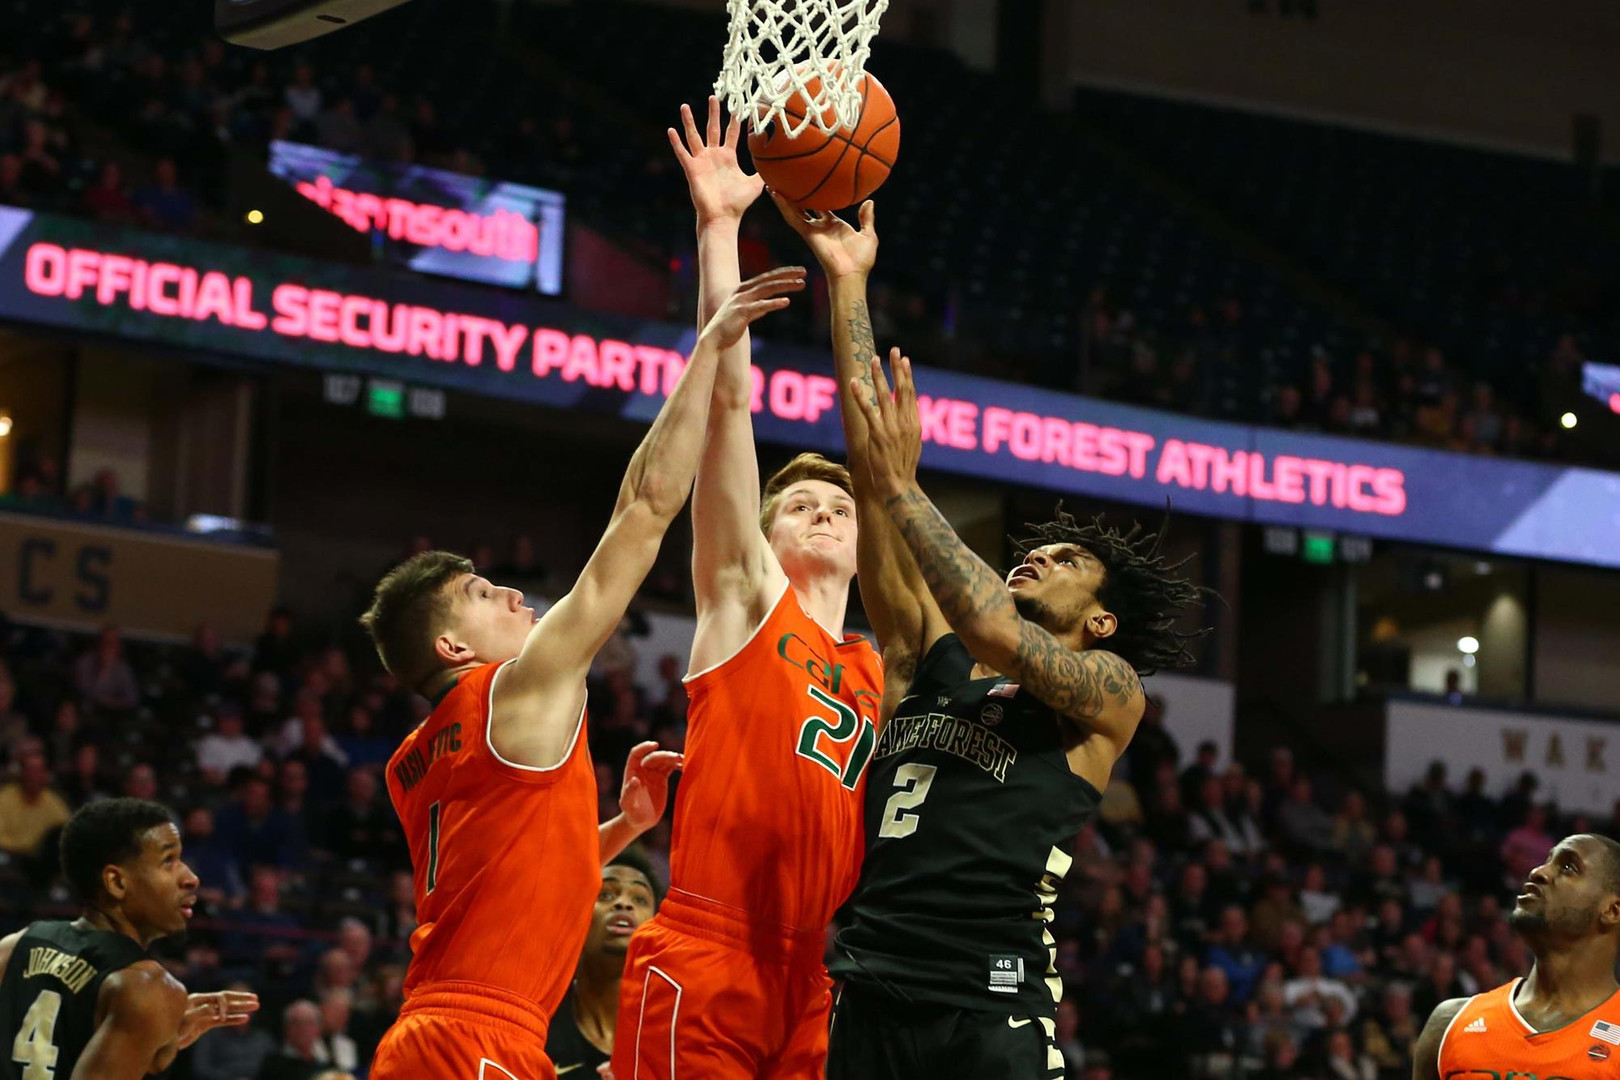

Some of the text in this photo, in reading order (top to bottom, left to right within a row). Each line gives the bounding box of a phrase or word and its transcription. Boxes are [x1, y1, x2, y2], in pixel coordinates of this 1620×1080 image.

[26, 244, 266, 329] OFFICIAL
[272, 285, 527, 371] SECURITY
[532, 328, 765, 413] PARTNR
[770, 370, 837, 422] OF
[914, 395, 979, 449] KE
[982, 406, 1155, 479] FOREST
[1156, 439, 1406, 515] ATHLETICS
[795, 684, 877, 791] 21
[874, 712, 1018, 784] AKE FOREST
[878, 762, 938, 839] 2
[426, 800, 441, 896] 1
[23, 946, 98, 995] JOHNSON
[995, 959, 1012, 969] 46
[12, 988, 62, 1080] 4
